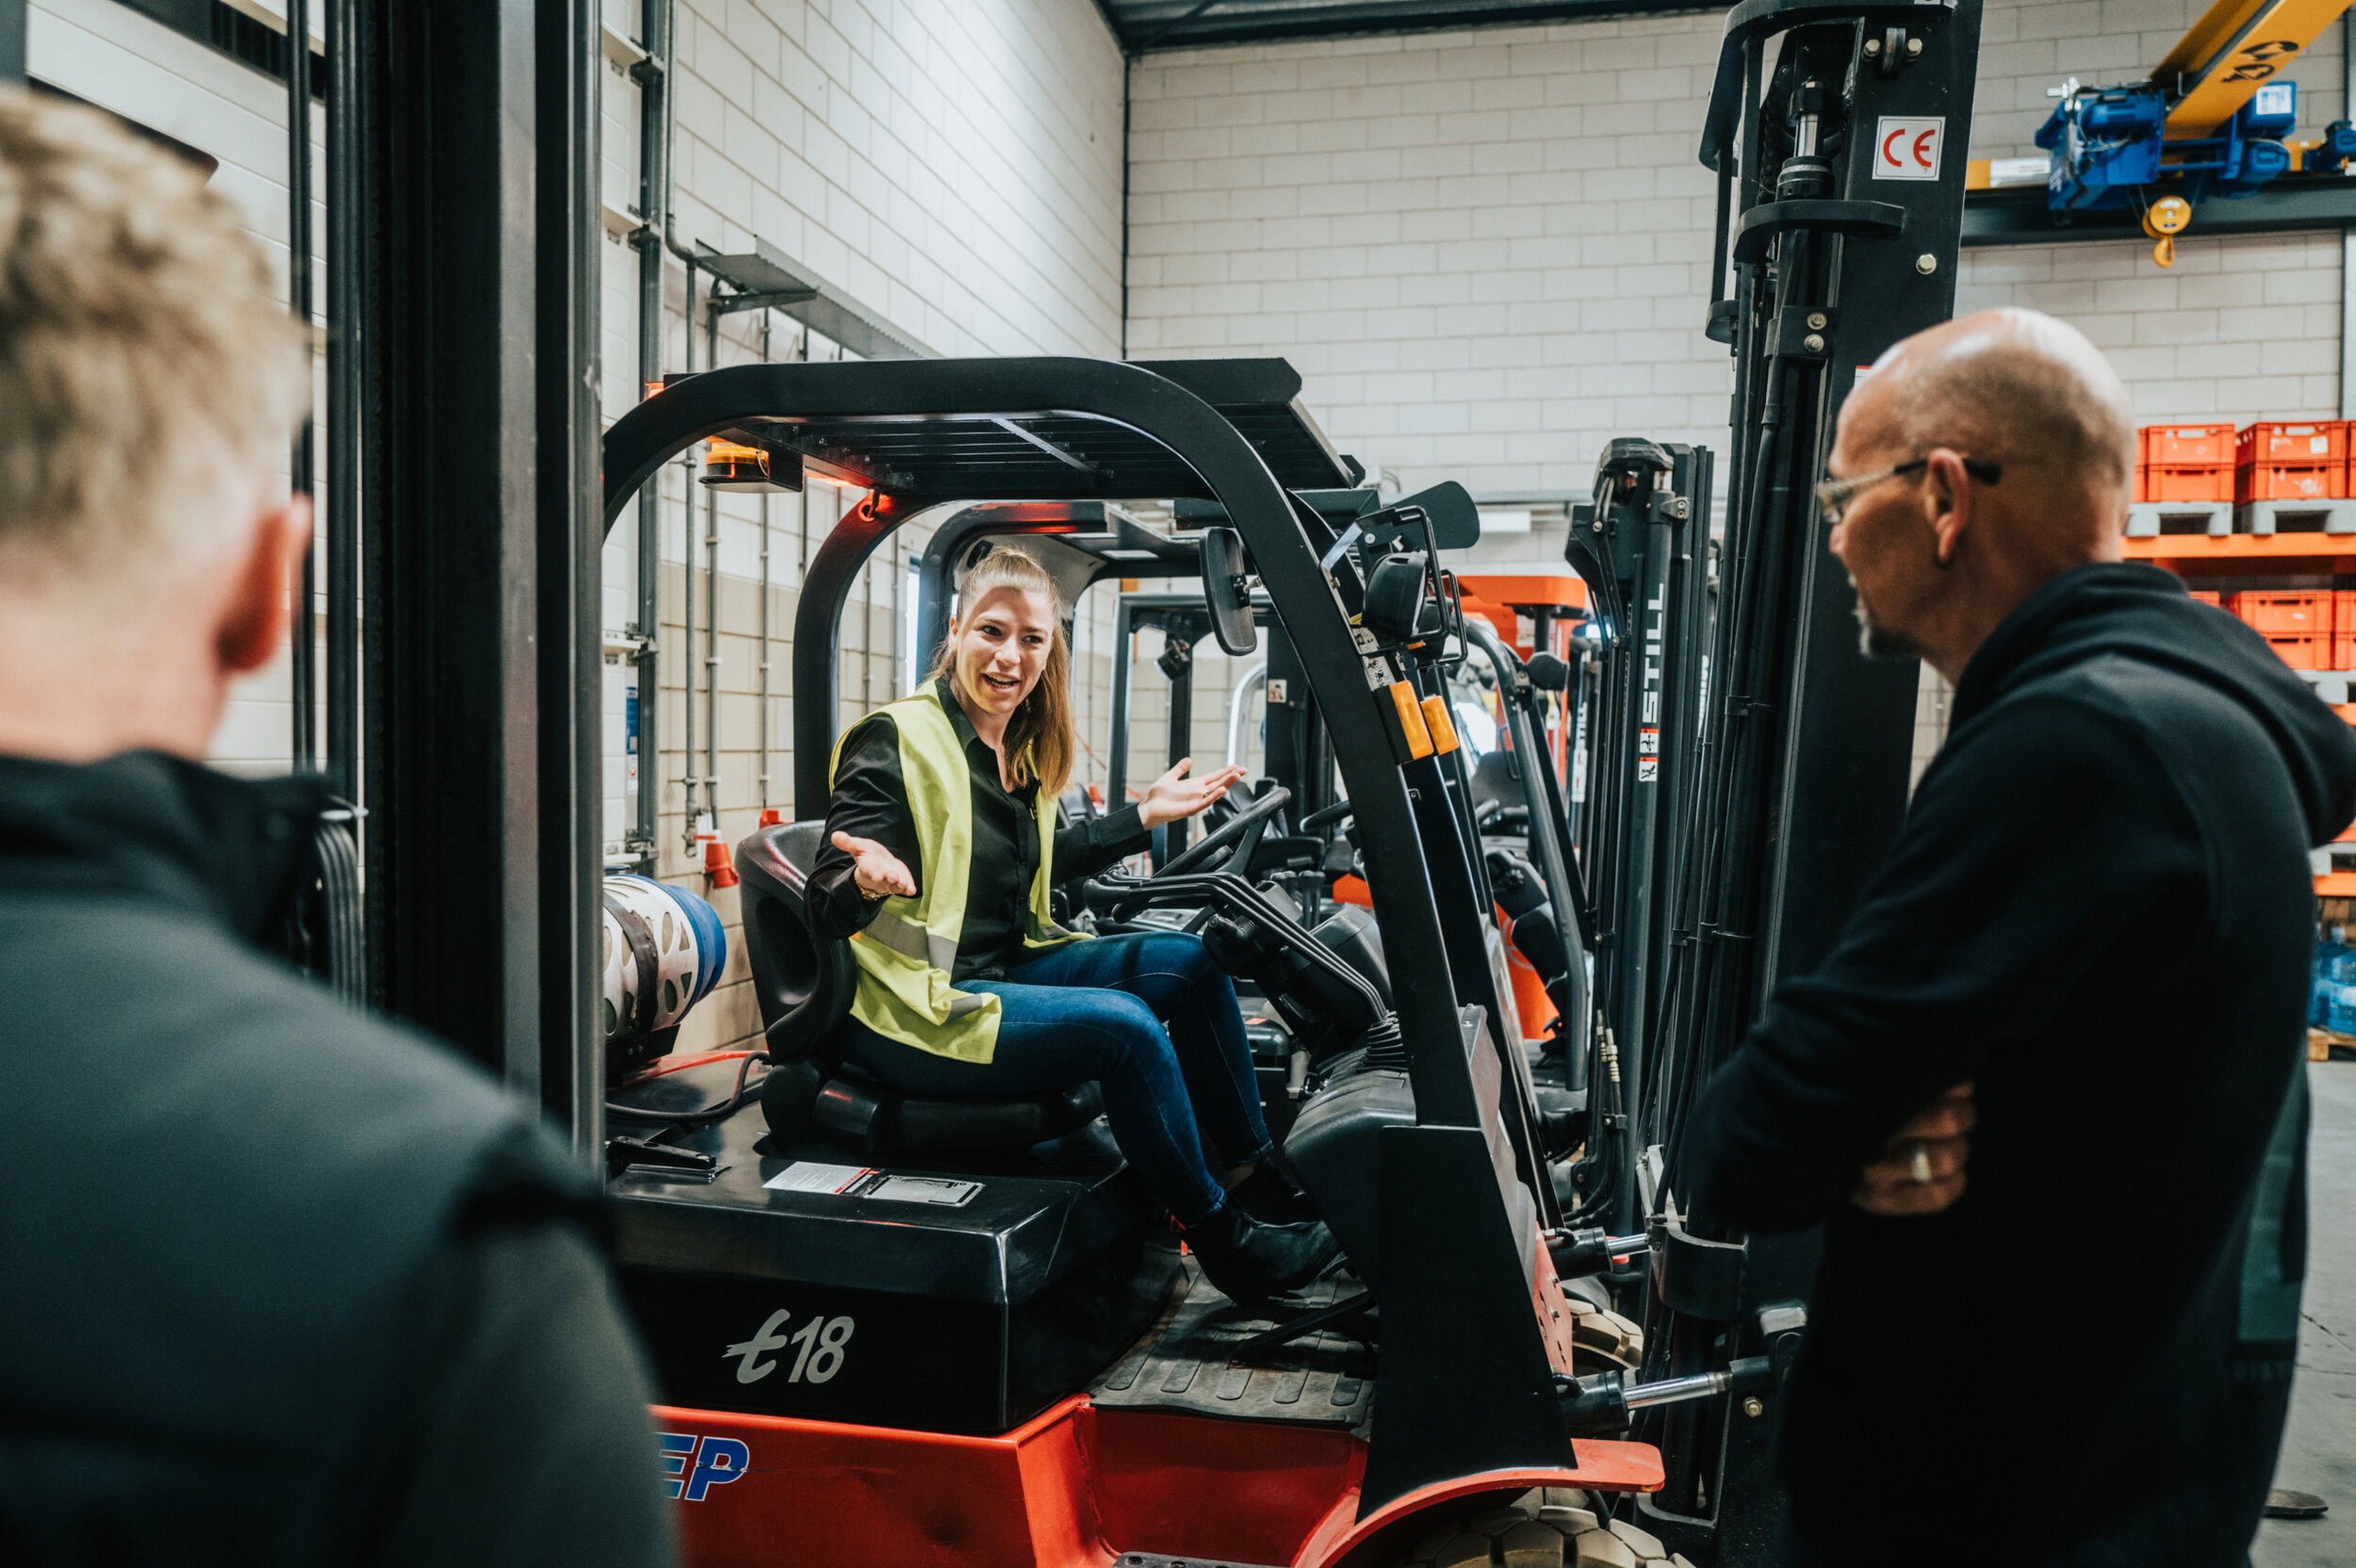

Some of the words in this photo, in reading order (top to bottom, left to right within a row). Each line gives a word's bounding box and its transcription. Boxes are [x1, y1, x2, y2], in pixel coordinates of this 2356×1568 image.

[1883, 128, 1936, 168] CE
[1642, 582, 1664, 724] STILL
[656, 1432, 750, 1501] EP
